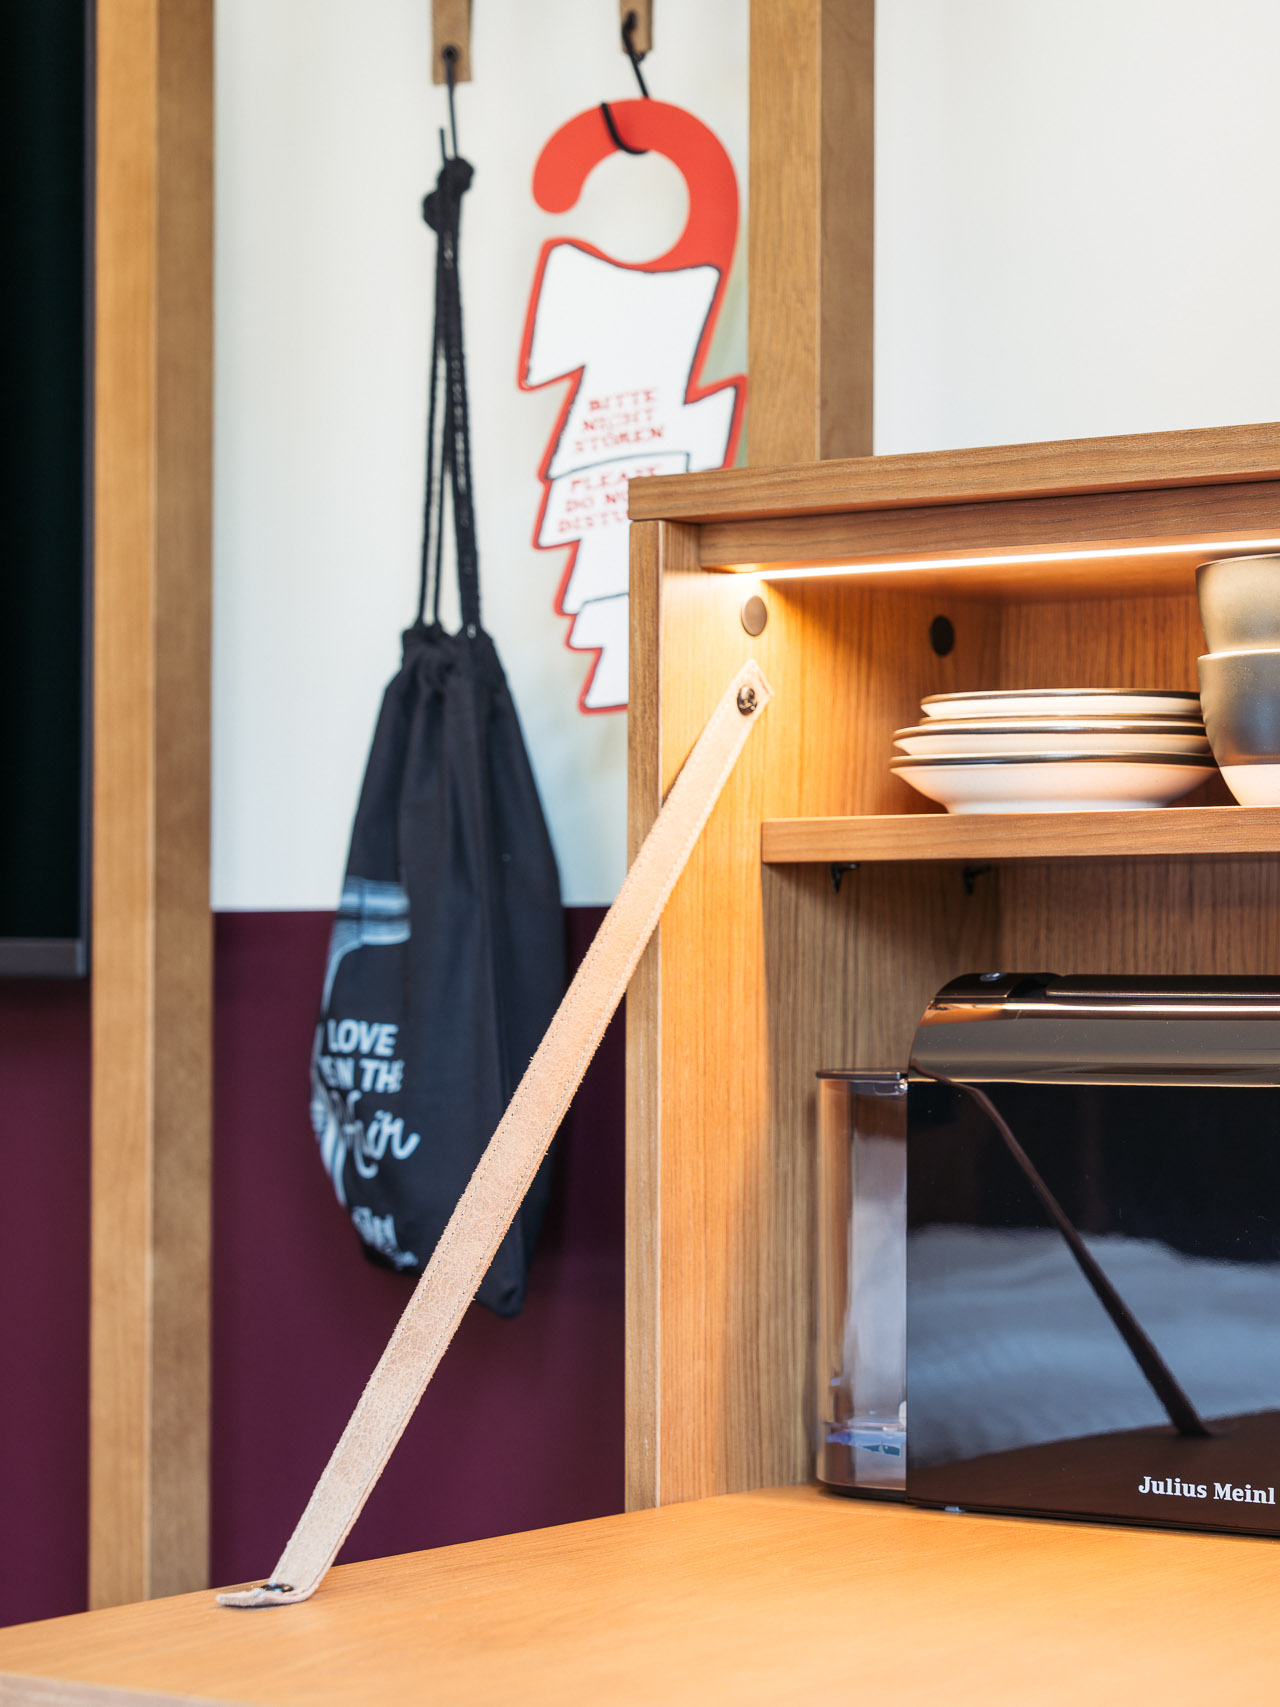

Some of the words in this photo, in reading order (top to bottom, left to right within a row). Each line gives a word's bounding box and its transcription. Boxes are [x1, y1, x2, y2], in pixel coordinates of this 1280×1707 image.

[589, 387, 657, 411] BITTE
[583, 409, 654, 431] NICHT
[605, 490, 629, 505] NO
[558, 510, 629, 533] DISTU
[327, 1018, 399, 1056] LOVE
[1138, 1476, 1207, 1498] Julius
[1213, 1483, 1276, 1504] Meinl
